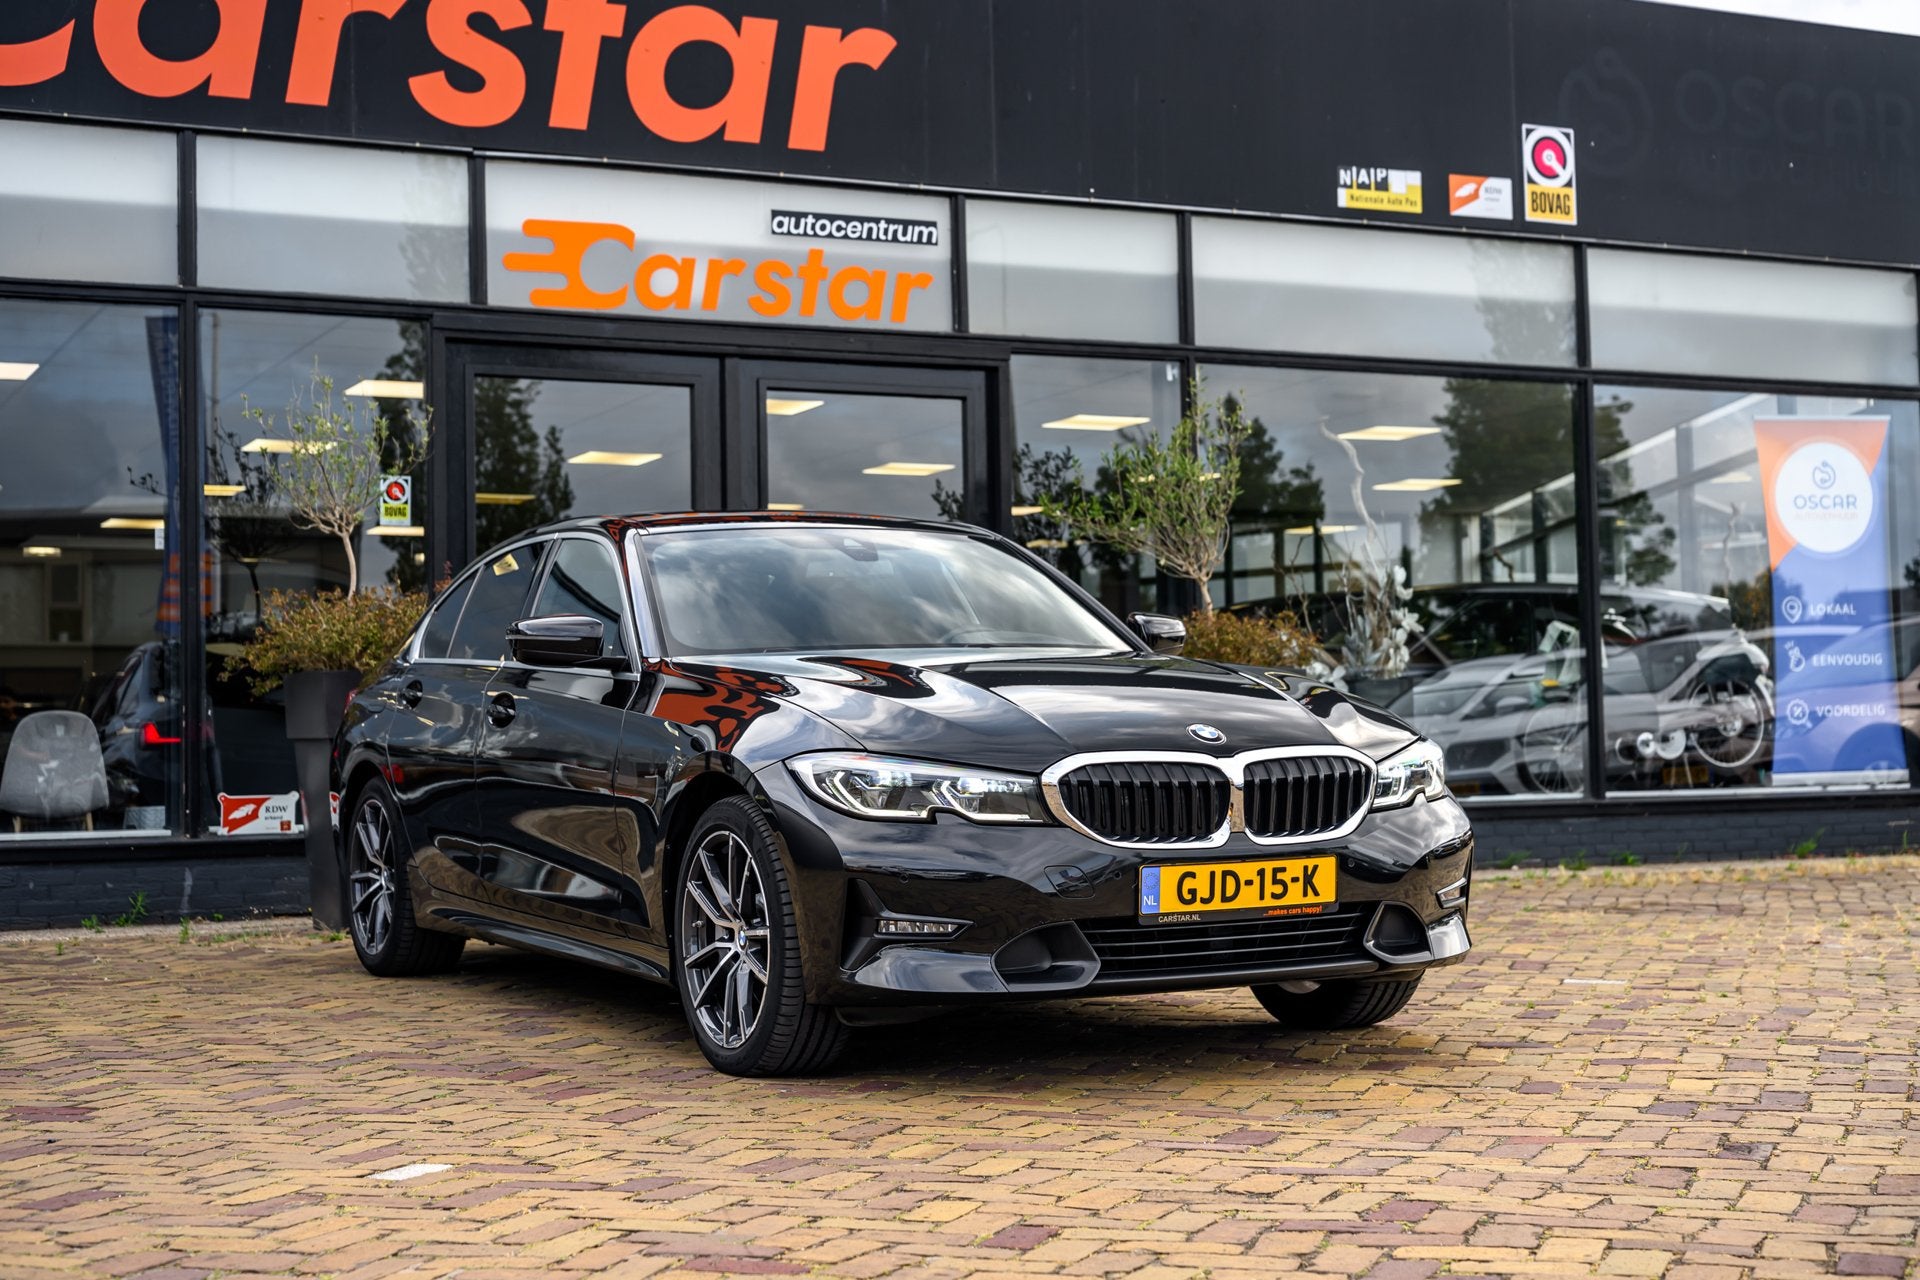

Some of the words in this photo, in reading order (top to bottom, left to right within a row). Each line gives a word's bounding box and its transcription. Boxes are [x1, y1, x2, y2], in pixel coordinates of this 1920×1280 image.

[0, 0, 898, 152] arstar
[1531, 191, 1571, 216] BOVAG
[771, 214, 938, 245] autocentrum
[502, 218, 934, 323] Carstar
[1793, 494, 1858, 510] OSCAR
[384, 506, 407, 518] BOVAG
[1808, 603, 1857, 616] LOKAAL
[1812, 653, 1883, 667] EENVOUDIG
[1815, 703, 1886, 718] VOORDELIG
[265, 805, 288, 813] RDW
[1176, 864, 1321, 905] GJD-15-K
[1143, 895, 1157, 906] NL
[1288, 907, 1301, 915] cars
[1302, 904, 1323, 914] happy!
[1158, 914, 1201, 923] CARSTAR.NL
